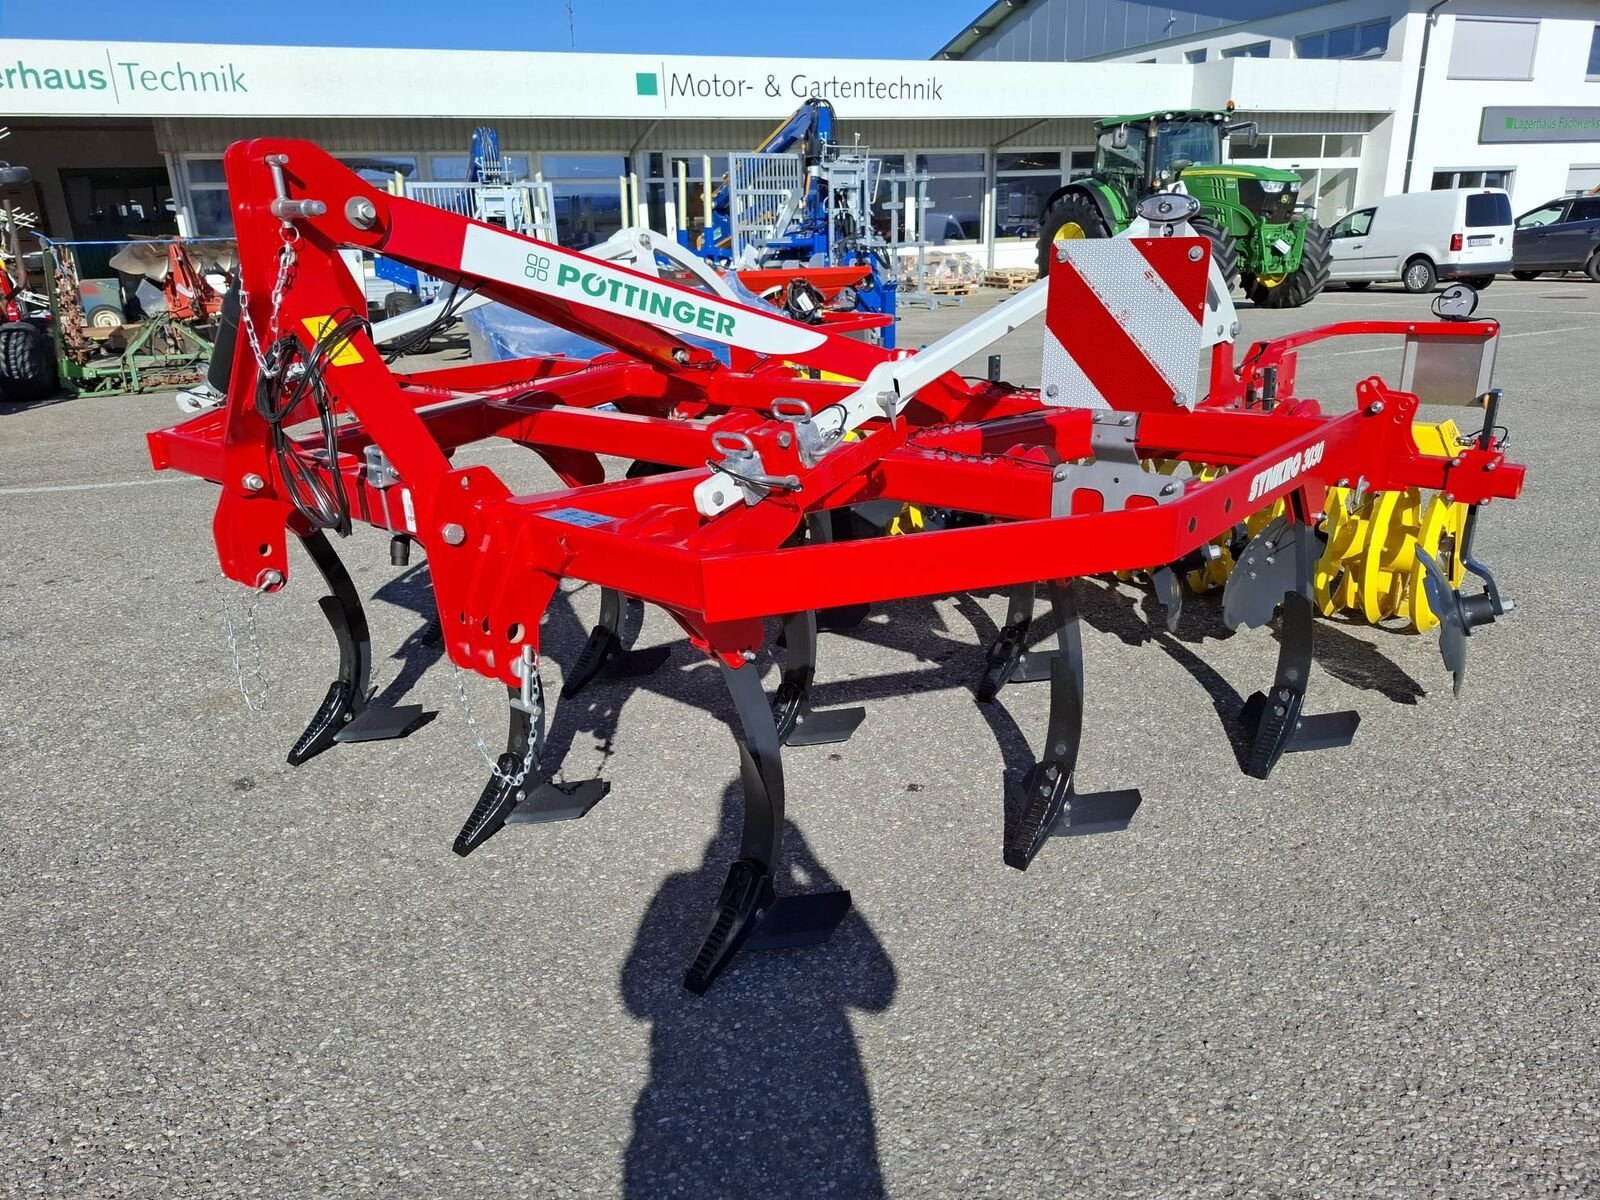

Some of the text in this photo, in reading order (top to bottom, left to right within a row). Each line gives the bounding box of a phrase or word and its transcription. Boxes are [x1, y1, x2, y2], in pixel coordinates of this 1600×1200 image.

[0, 60, 249, 93] rhaus Technik
[670, 72, 943, 101] Motor- & Gartentechnik
[1513, 117, 1556, 132] Lagerhaus
[1247, 451, 1302, 502] SYNKRO
